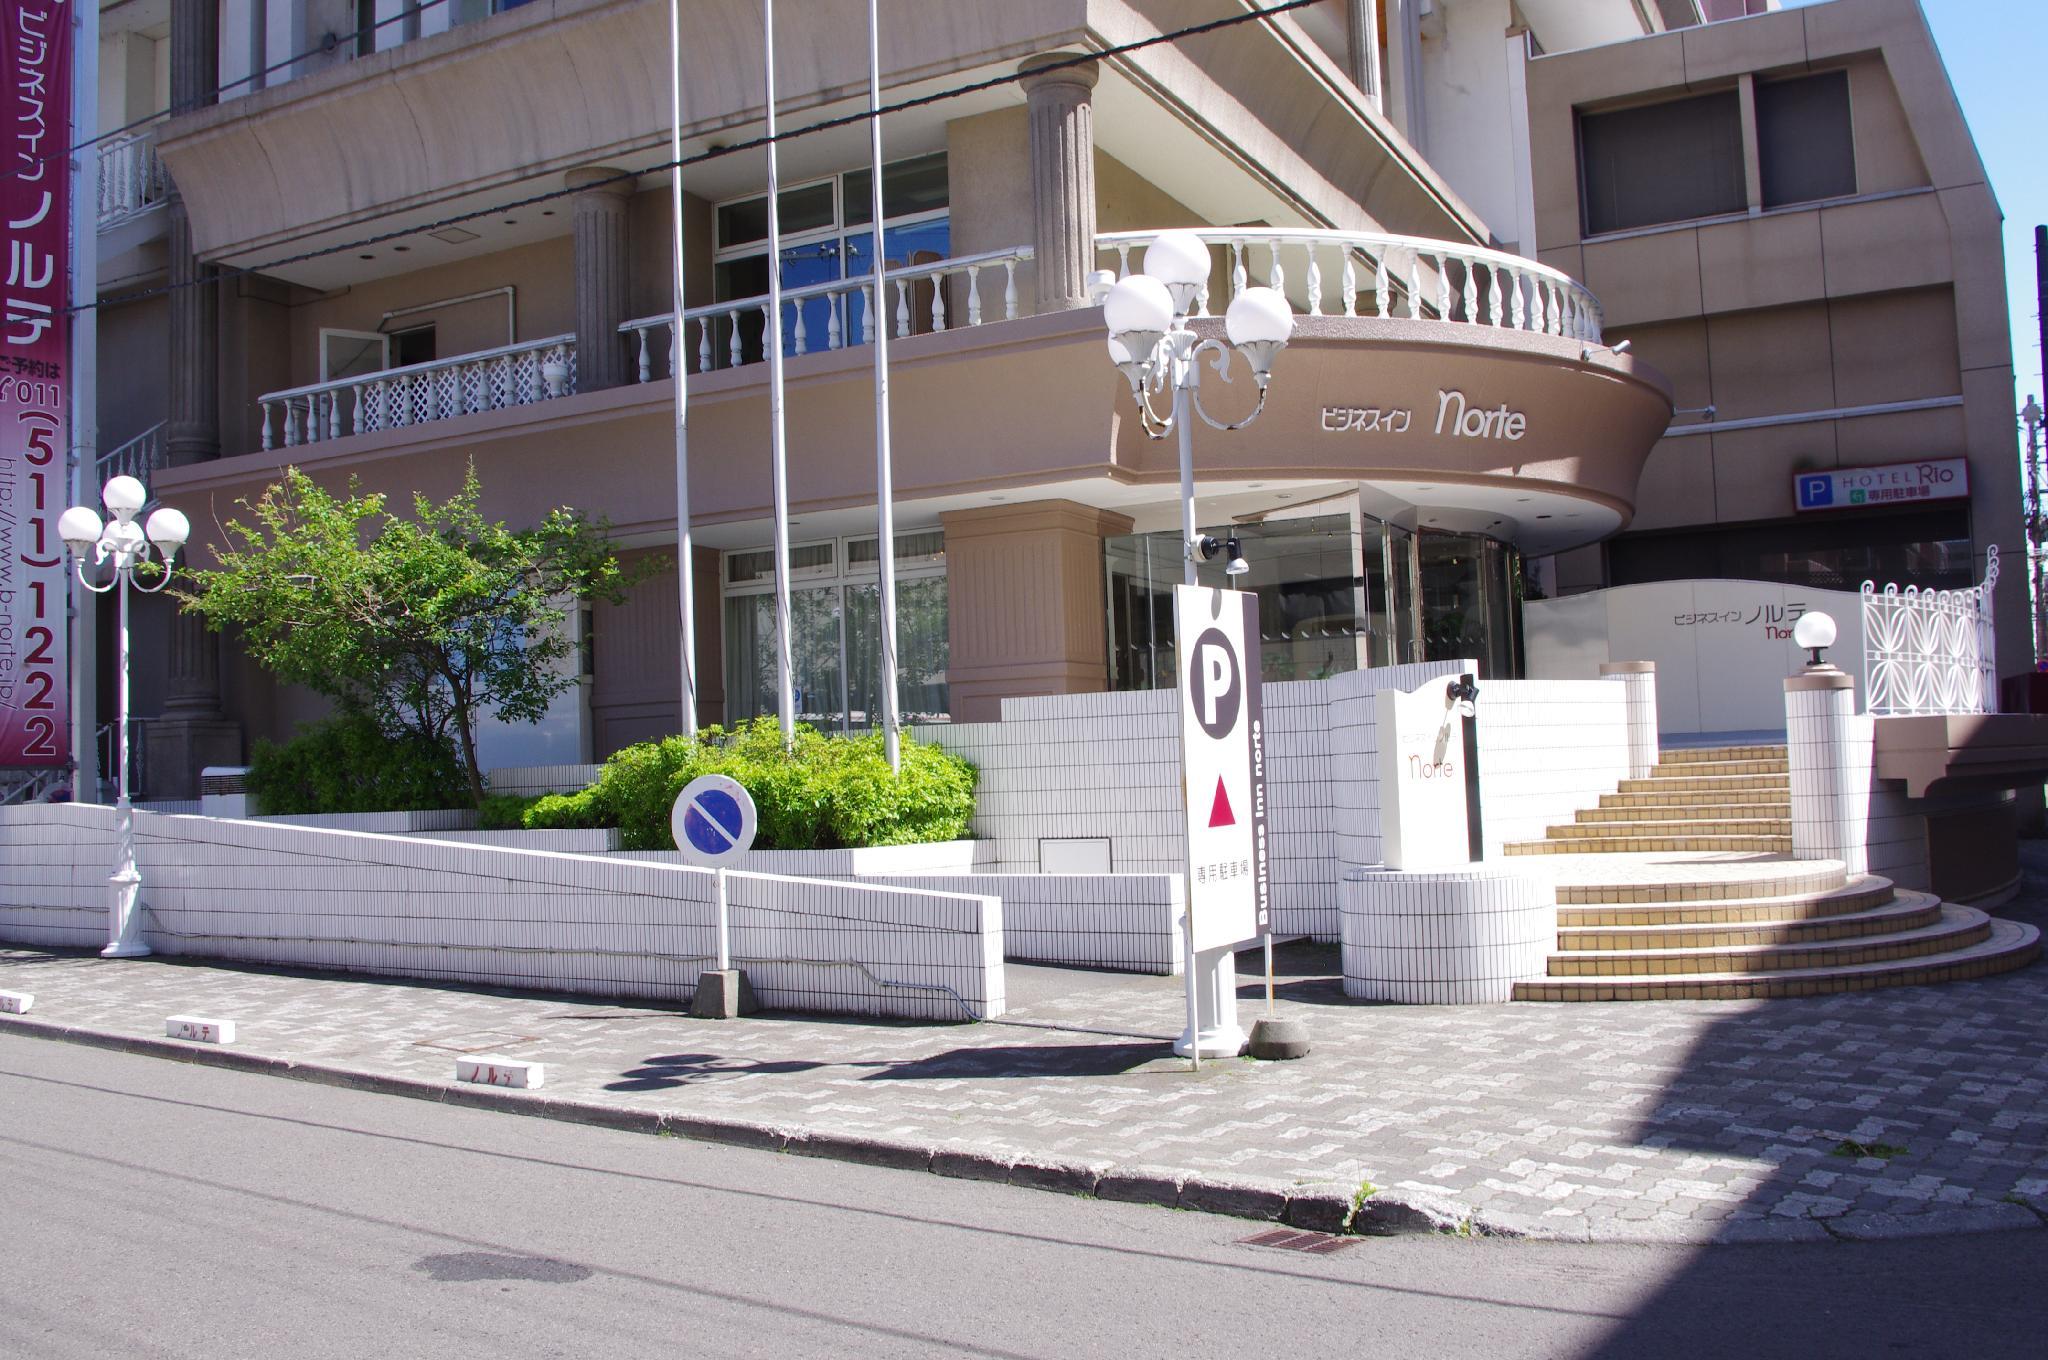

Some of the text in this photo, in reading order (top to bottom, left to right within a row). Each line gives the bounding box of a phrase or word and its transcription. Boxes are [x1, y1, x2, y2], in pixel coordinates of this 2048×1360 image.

[6, 6, 54, 345] ビジネスイン ノルテ
[16, 380, 60, 408] 011
[1321, 407, 1412, 433] ビジネスイン
[1842, 471, 1912, 488] HOTEL
[1916, 464, 1954, 485] Rio
[1674, 611, 1742, 626] ビジネスイン
[1202, 643, 1232, 724] P
[1252, 719, 1269, 925] Business Inn norte
